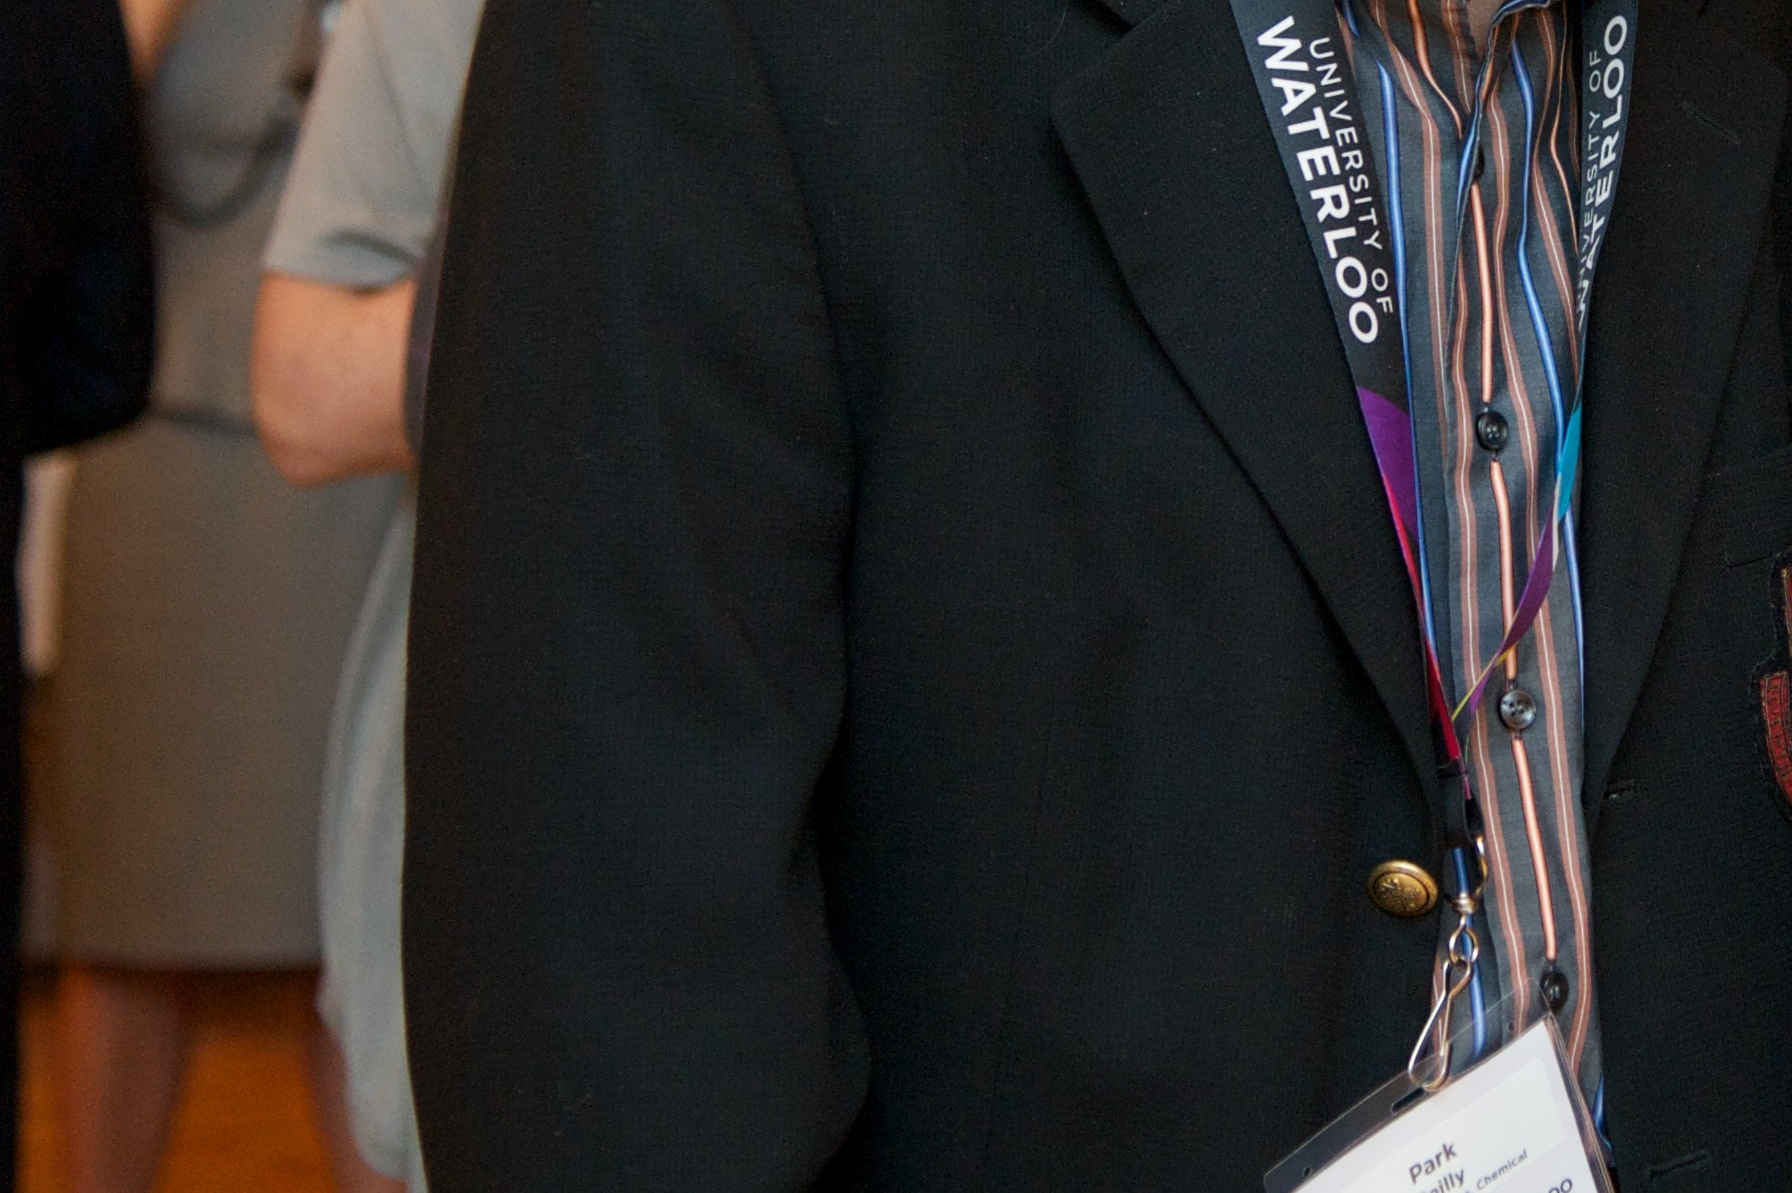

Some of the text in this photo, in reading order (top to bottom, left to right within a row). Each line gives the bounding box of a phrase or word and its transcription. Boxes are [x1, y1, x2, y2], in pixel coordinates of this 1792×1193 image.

[1589, 51, 1602, 92] OF
[1256, 15, 1379, 344] WATERLOO
[1308, 36, 1393, 314] UNIVERSITY OF
[1578, 14, 1628, 333] WATERLOO
[1408, 1141, 1458, 1184] Park
[1476, 1148, 1528, 1190] Chemical
